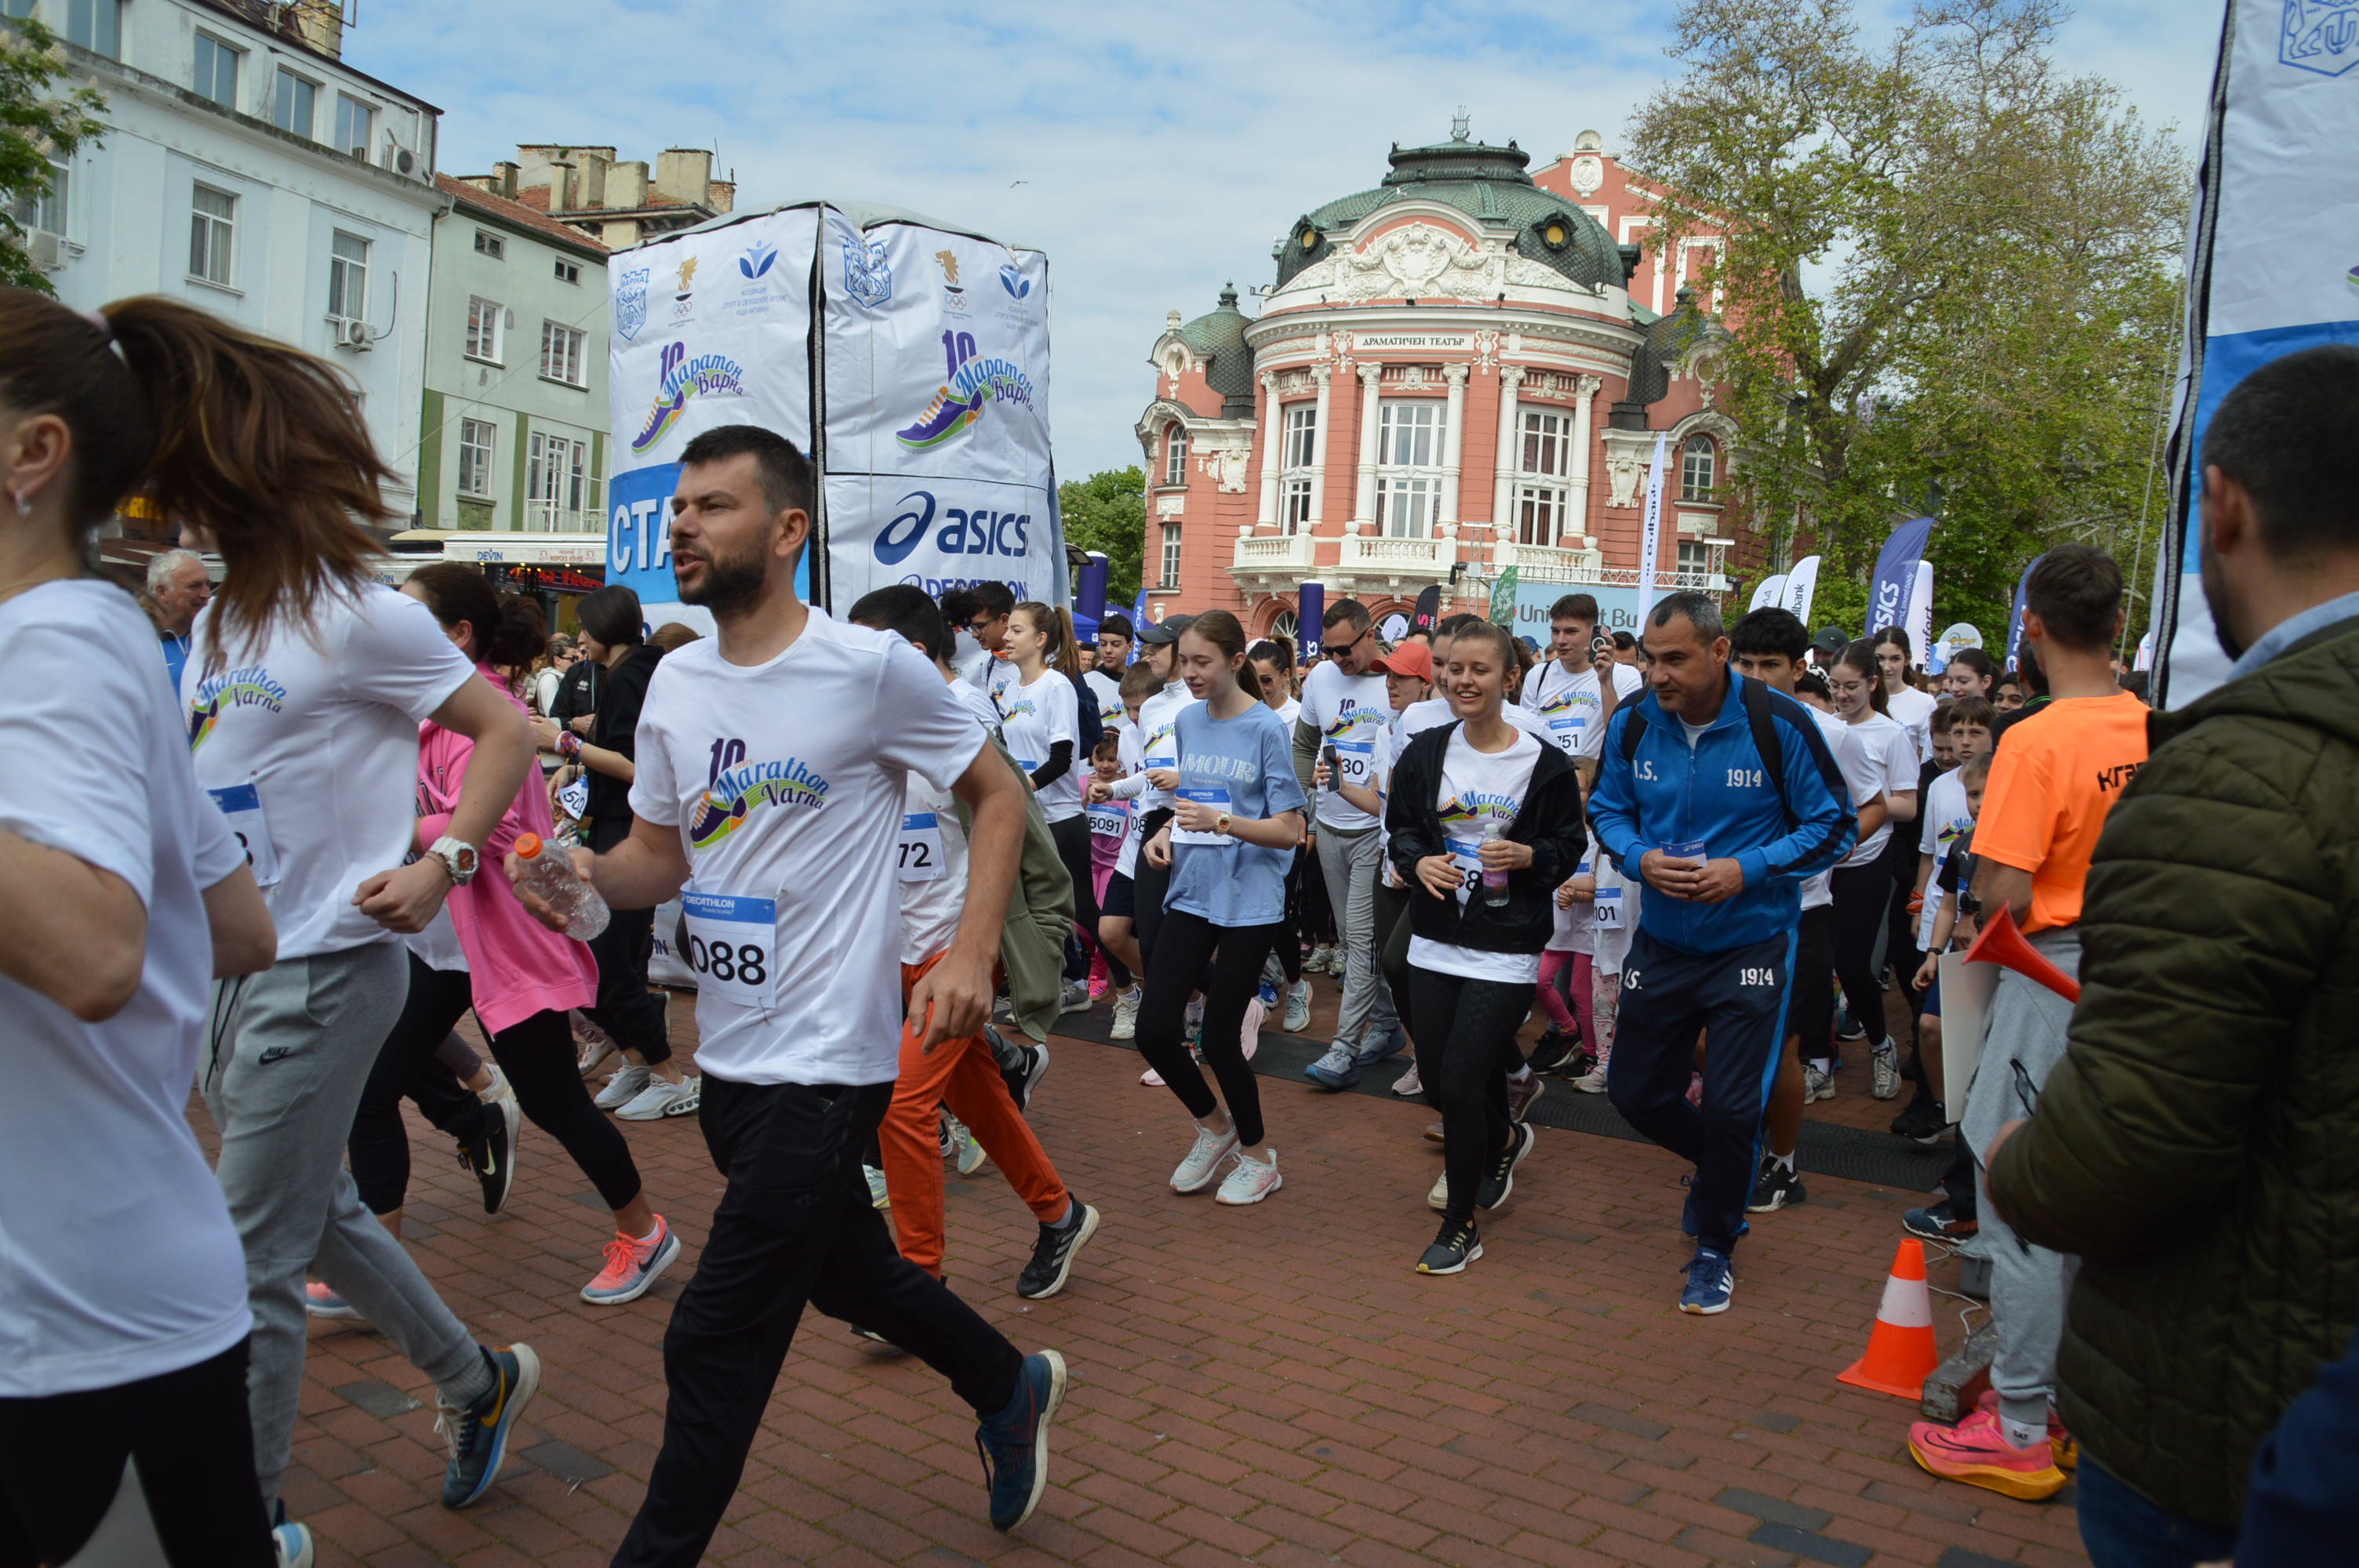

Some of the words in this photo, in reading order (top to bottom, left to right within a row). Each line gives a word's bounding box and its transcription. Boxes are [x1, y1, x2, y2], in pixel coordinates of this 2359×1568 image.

[942, 328, 977, 383] 10
[1362, 337, 1426, 347] ДРАМАТИЧЕН
[1430, 337, 1465, 347] ТЕАТЪР
[660, 341, 685, 391] 10
[664, 354, 743, 402] Маратон
[695, 372, 744, 396] Варна
[955, 358, 1034, 402] Маратон
[991, 376, 1034, 414] Варна
[612, 497, 672, 573] СТА
[477, 550, 503, 561] DEVIN
[199, 664, 287, 705] Marathon
[229, 684, 282, 713] Varna
[1339, 698, 1356, 716] 10
[1342, 706, 1387, 722] Marathon
[1361, 714, 1382, 726] Varn
[709, 738, 747, 790] 10
[1180, 753, 1256, 783] MOUR
[717, 757, 829, 808] Marathon
[1726, 768, 1763, 788] 1914
[761, 780, 824, 810] Varna
[1089, 816, 1120, 834] 5091
[1488, 804, 1518, 824] Varn
[899, 842, 932, 869] 72
[686, 895, 735, 909] DECATHLON
[1594, 906, 1616, 922] 101
[1739, 967, 1775, 986] 1914
